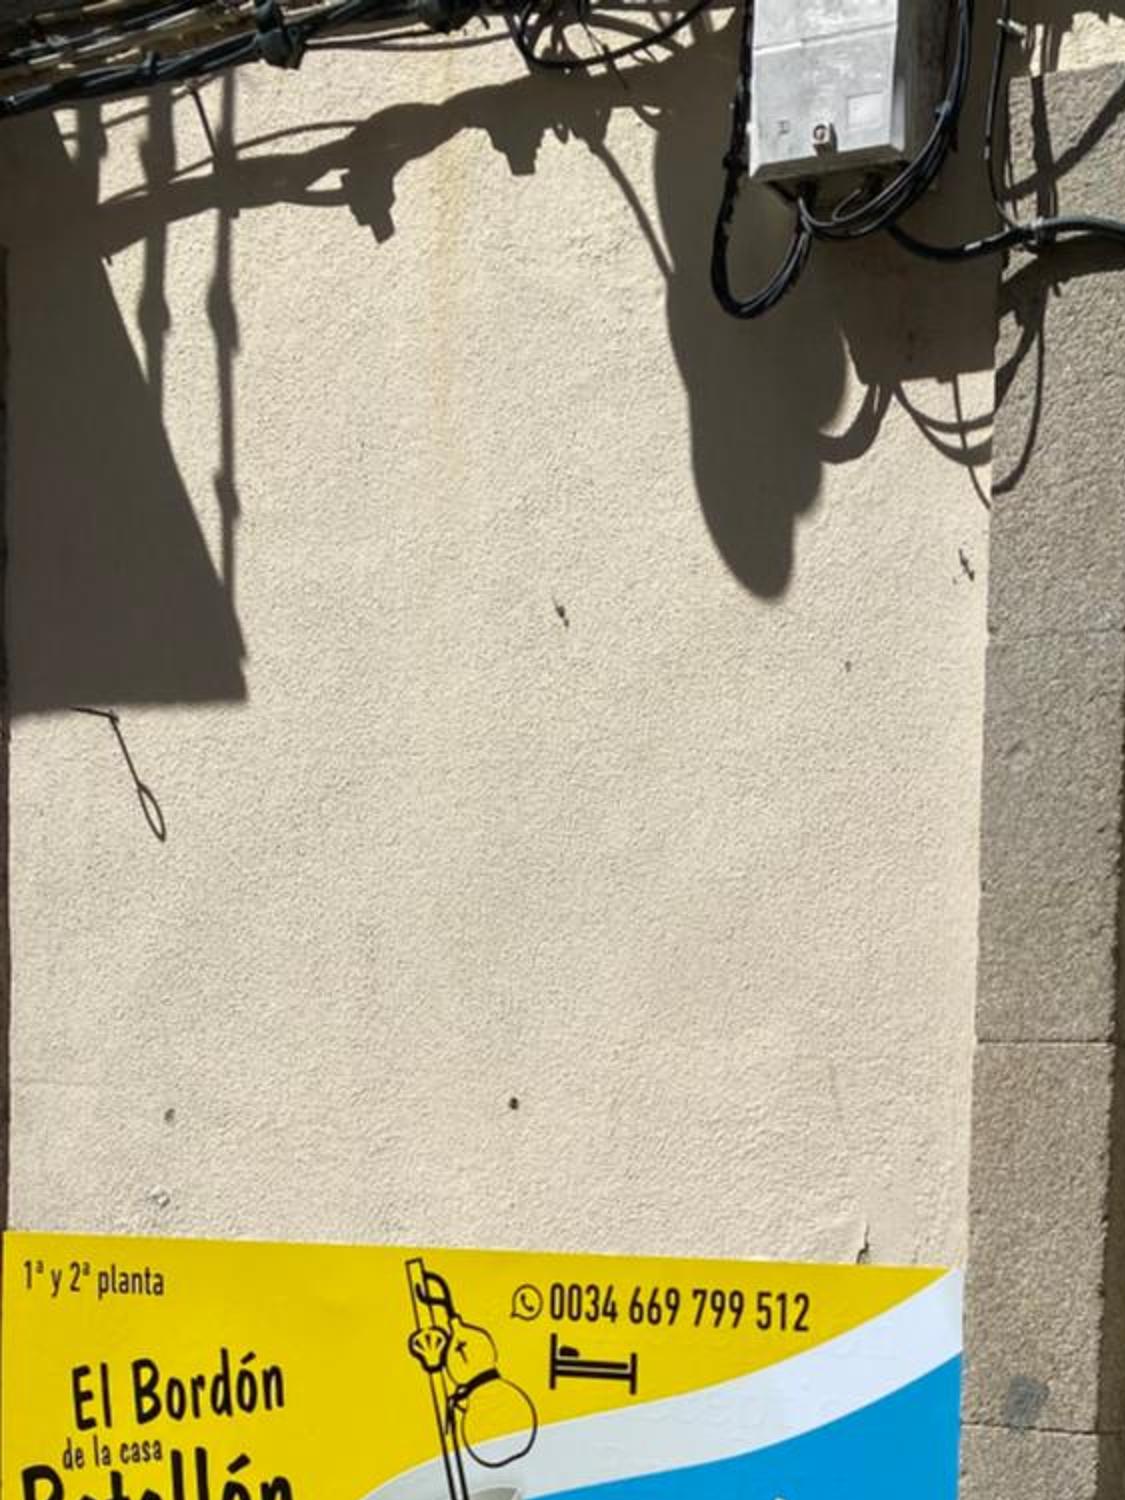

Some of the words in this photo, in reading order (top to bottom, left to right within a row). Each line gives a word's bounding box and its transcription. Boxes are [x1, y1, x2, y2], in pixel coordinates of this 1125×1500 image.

[23, 1259, 45, 1290] 1ª
[50, 1268, 63, 1299] y
[69, 1260, 91, 1292] 2ª
[98, 1263, 165, 1301] planta
[549, 1281, 619, 1325] 0034
[628, 1286, 681, 1327] 669
[691, 1288, 745, 1330] 799
[755, 1291, 811, 1334] 512
[71, 1361, 113, 1432] El
[131, 1347, 285, 1426] Bordón
[62, 1437, 86, 1470] de
[93, 1435, 113, 1467] la
[119, 1438, 163, 1464] casa
